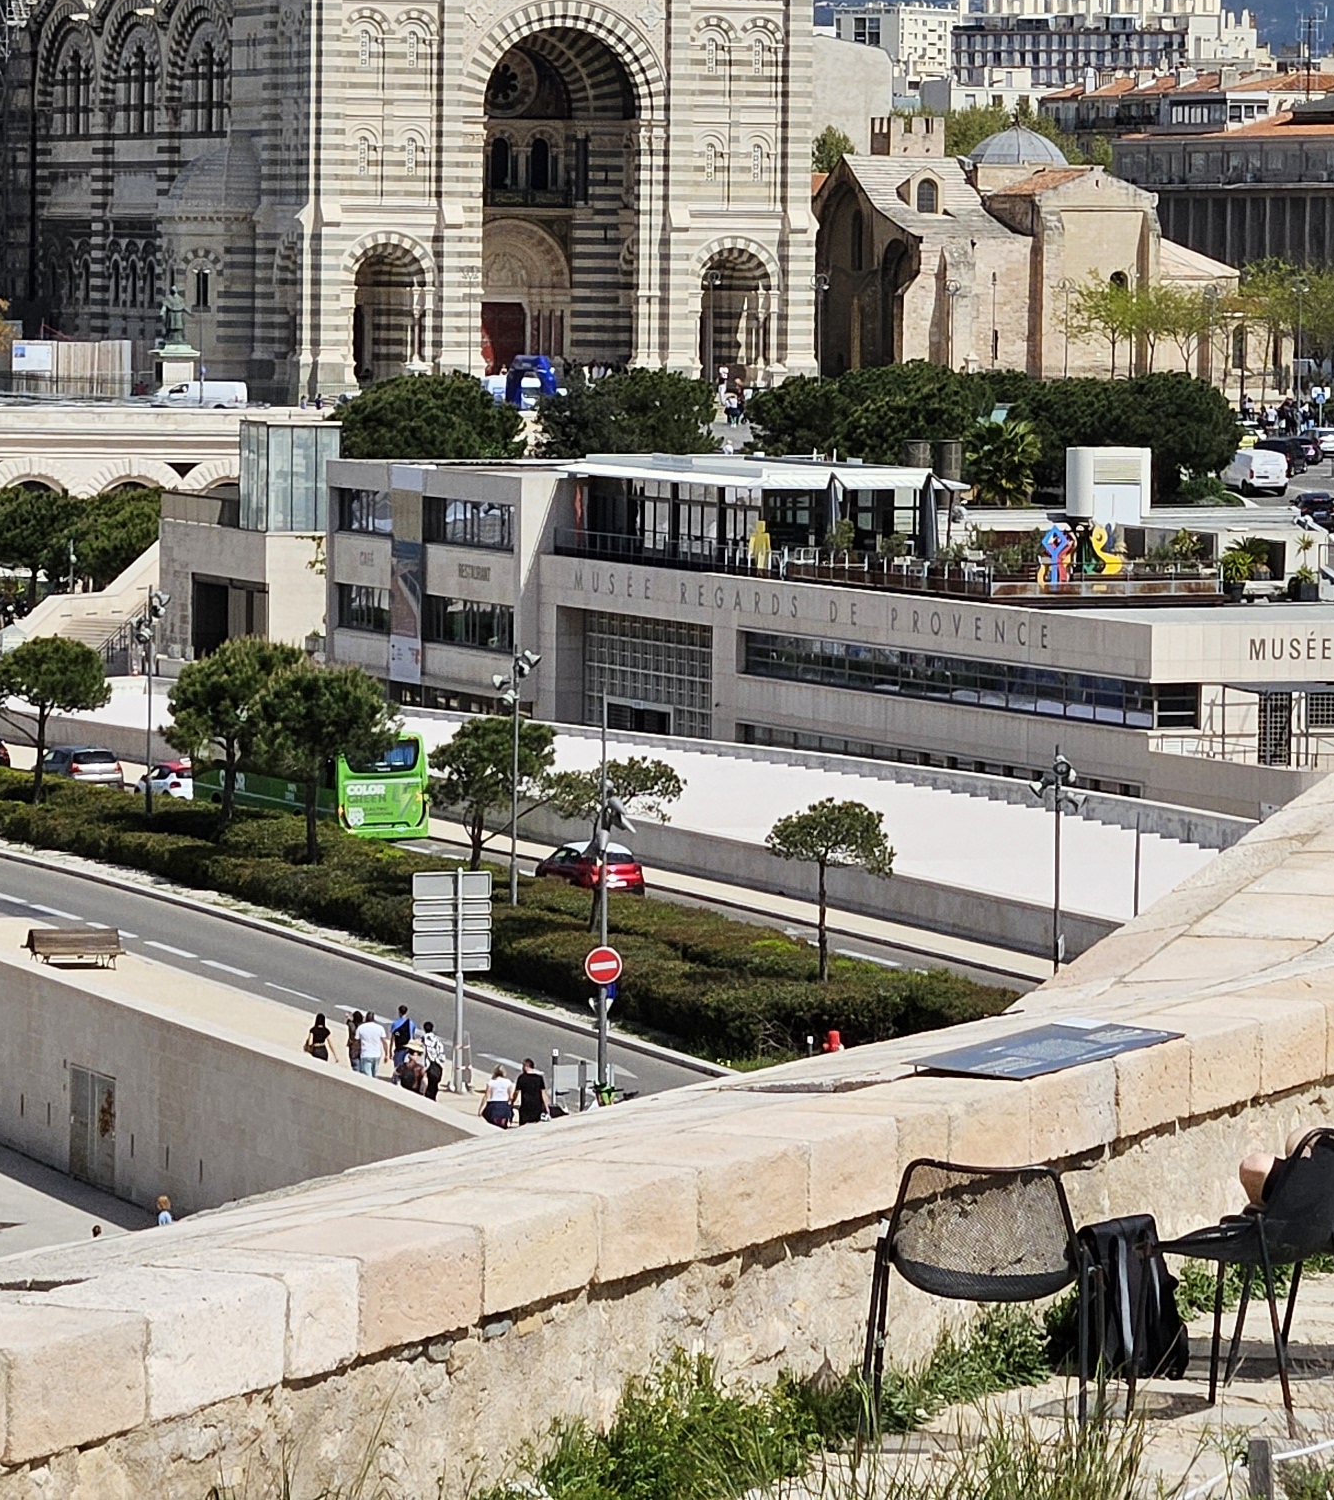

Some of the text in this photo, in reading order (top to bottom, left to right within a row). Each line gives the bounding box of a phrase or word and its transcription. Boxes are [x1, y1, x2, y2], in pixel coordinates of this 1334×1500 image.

[457, 562, 492, 582] RESTAURANT
[573, 569, 1048, 649] MUSÉE REGARDS DE PROVENCE
[1249, 630, 1332, 660] MUSÉE
[346, 784, 386, 795] COLOR
[347, 794, 387, 803] GREEN
